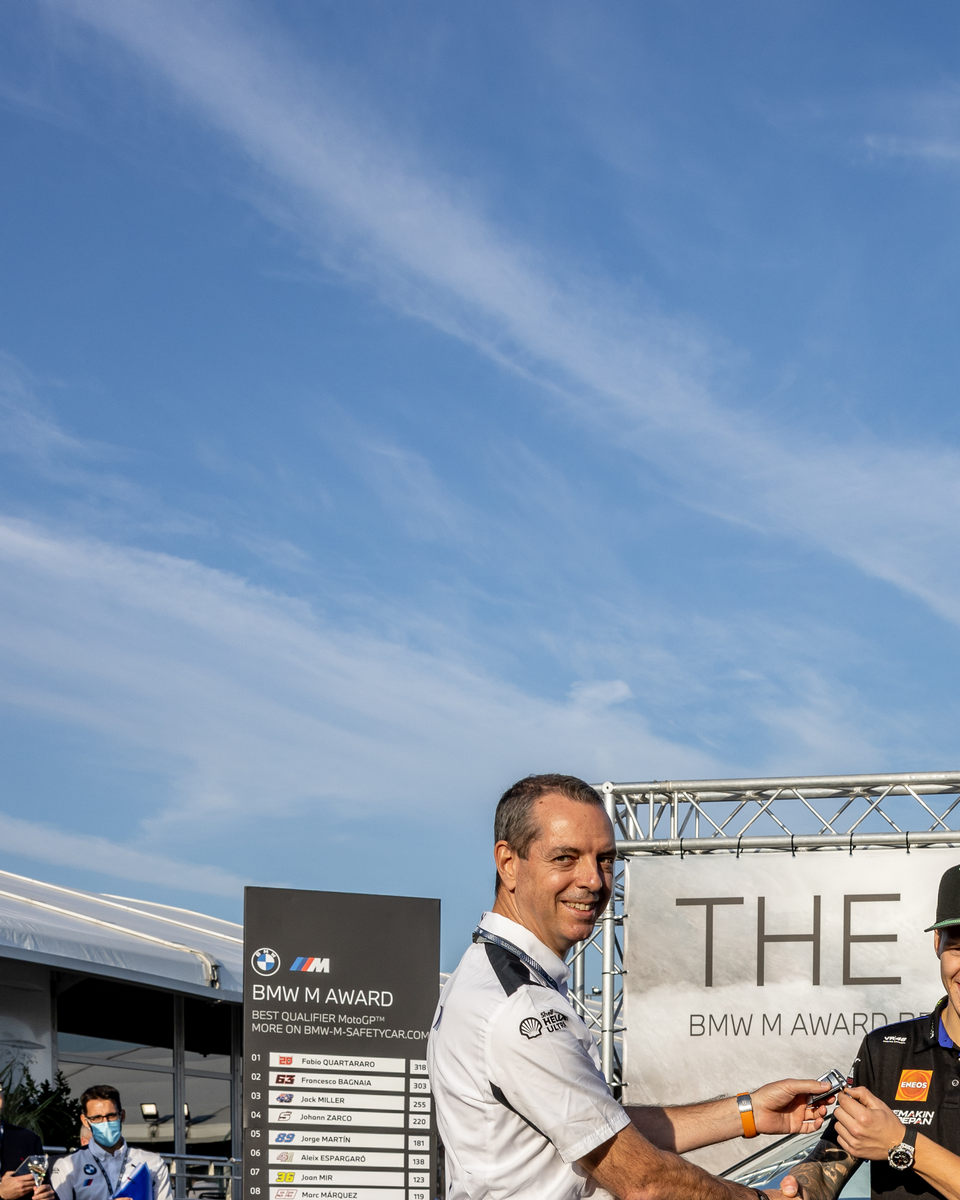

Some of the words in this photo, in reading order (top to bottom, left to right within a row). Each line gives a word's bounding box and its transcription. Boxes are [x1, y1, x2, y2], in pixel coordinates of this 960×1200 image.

[676, 893, 901, 987] THE
[253, 984, 299, 1002] BMW
[305, 987, 320, 1003] M
[325, 988, 393, 1007] AWARD
[252, 1010, 279, 1020] BEST
[281, 1011, 336, 1023] QUALIFIER
[689, 1013, 753, 1036] BMW
[762, 1013, 782, 1036] M
[791, 1012, 888, 1036] AWARD
[252, 1023, 283, 1034] MORE
[285, 1024, 302, 1034] ON
[304, 1025, 430, 1040] BMW-M-SAFETYCAR.COM
[323, 1059, 375, 1068] QUARTARARO
[275, 1074, 295, 1084] 63
[301, 1077, 336, 1085] Francesco
[892, 1109, 935, 1119] EMAKIN
[275, 1133, 295, 1143] 89
[276, 1172, 295, 1182] 36
